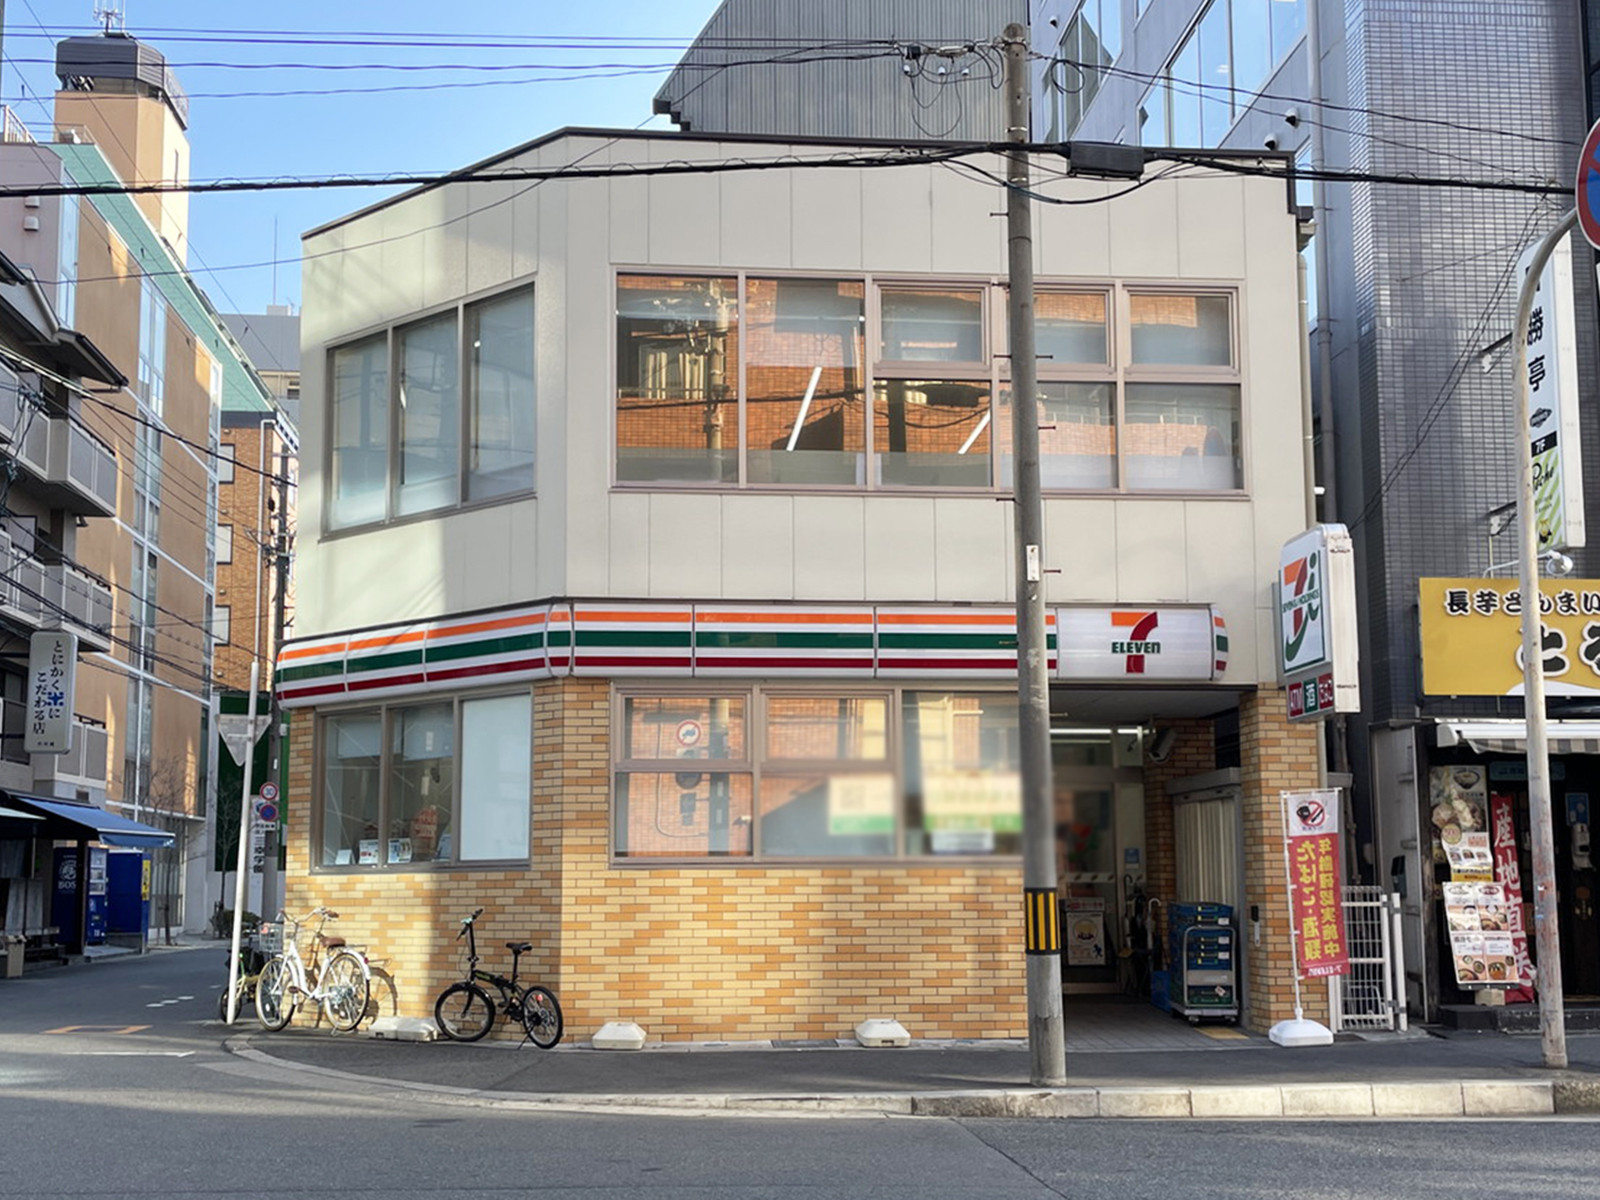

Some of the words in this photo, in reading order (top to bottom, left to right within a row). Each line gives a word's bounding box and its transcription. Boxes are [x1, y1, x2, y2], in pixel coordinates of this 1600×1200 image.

[33, 671, 48, 735] こだわる店
[57, 881, 77, 890] BOS
[1493, 803, 1537, 987] 産地直送
